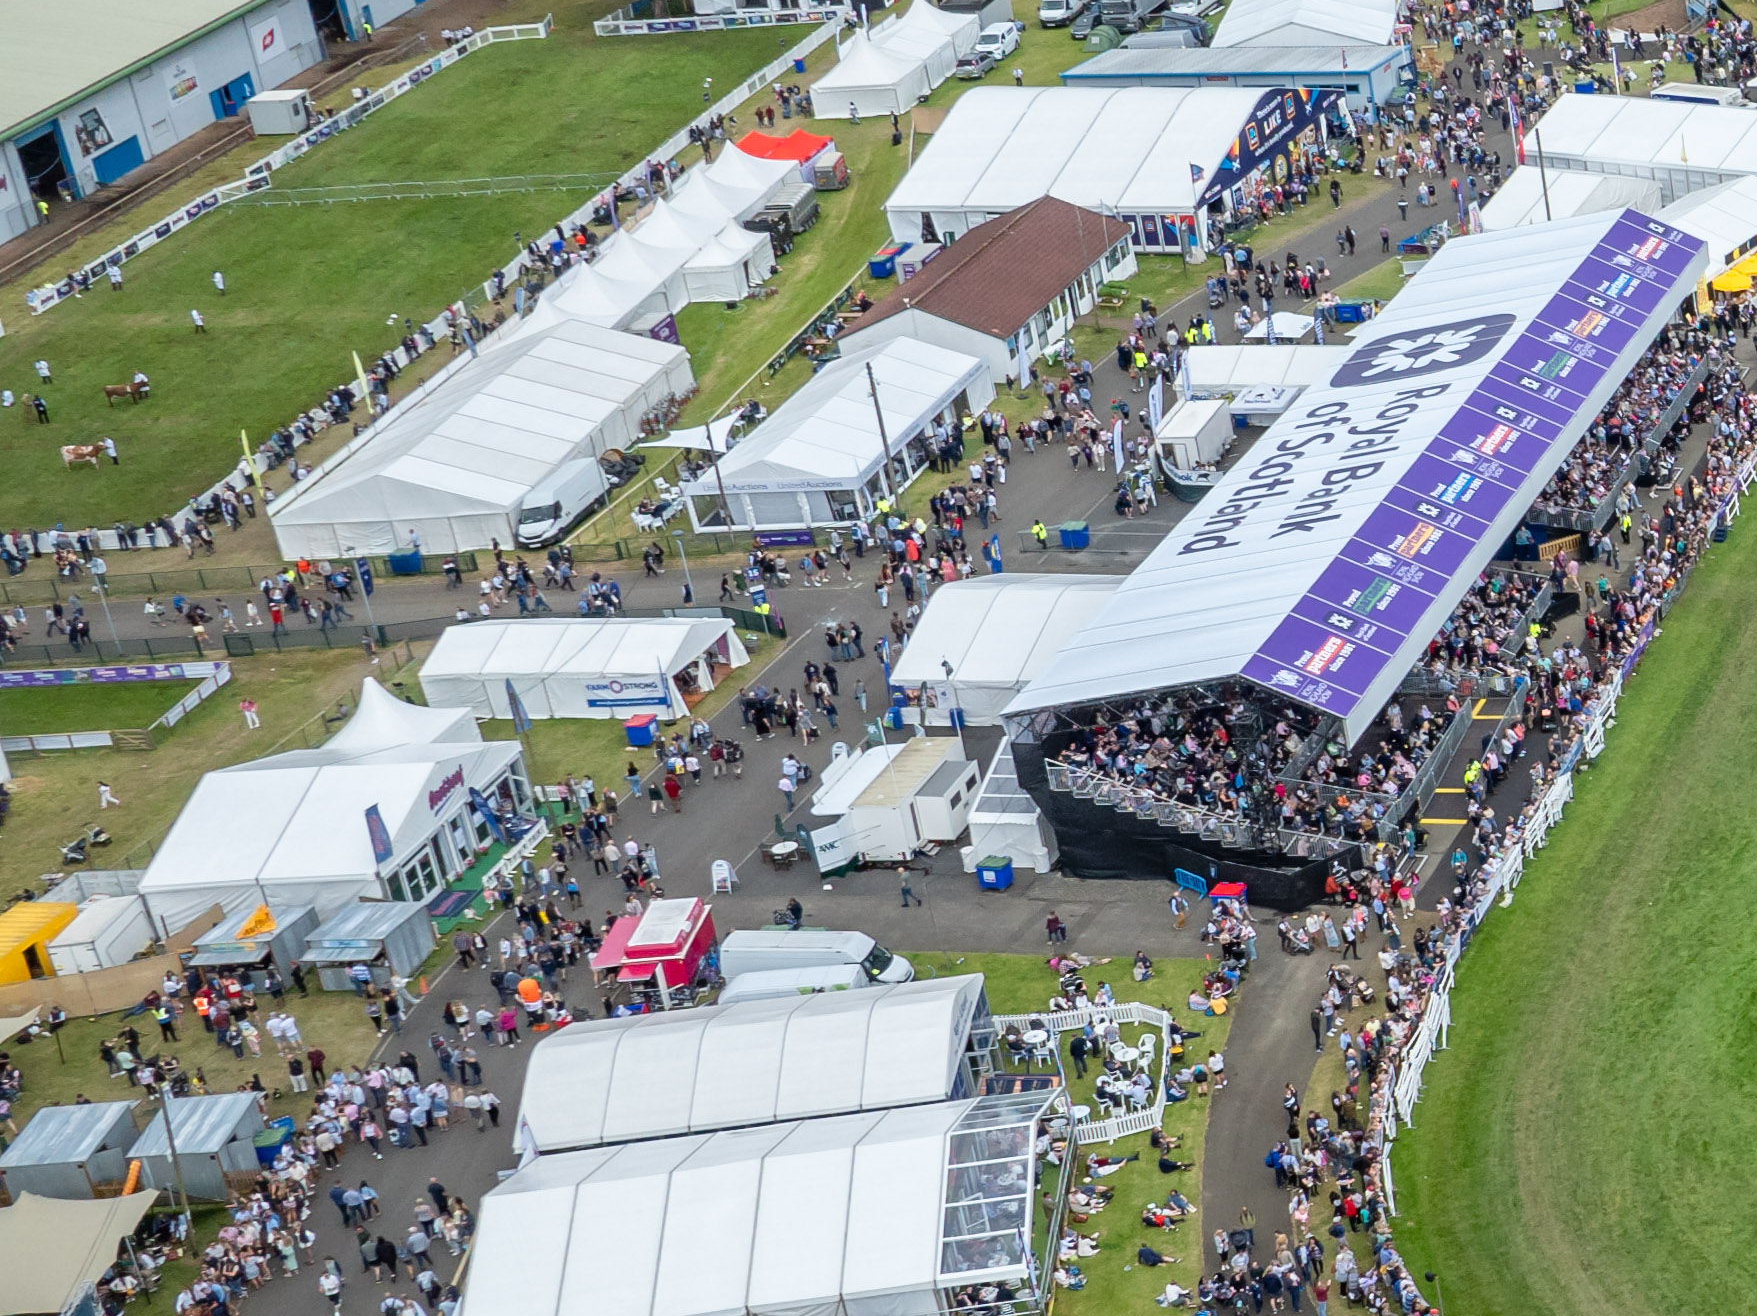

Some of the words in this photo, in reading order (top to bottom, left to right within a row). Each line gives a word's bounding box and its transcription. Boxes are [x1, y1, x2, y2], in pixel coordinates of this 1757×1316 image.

[1263, 109, 1282, 137] LIKE
[1294, 401, 1352, 431] of
[1339, 383, 1453, 462] Royal
[1176, 432, 1336, 556] Scotland
[1267, 461, 1386, 540] Bank
[1440, 471, 1471, 505] partners
[1400, 523, 1430, 557] partners
[747, 569, 759, 577] 15
[1342, 588, 1362, 608] Proud
[1356, 577, 1388, 614] partners
[1293, 649, 1314, 668] Proud
[1305, 636, 1343, 675] partners
[623, 682, 658, 690] STRONG
